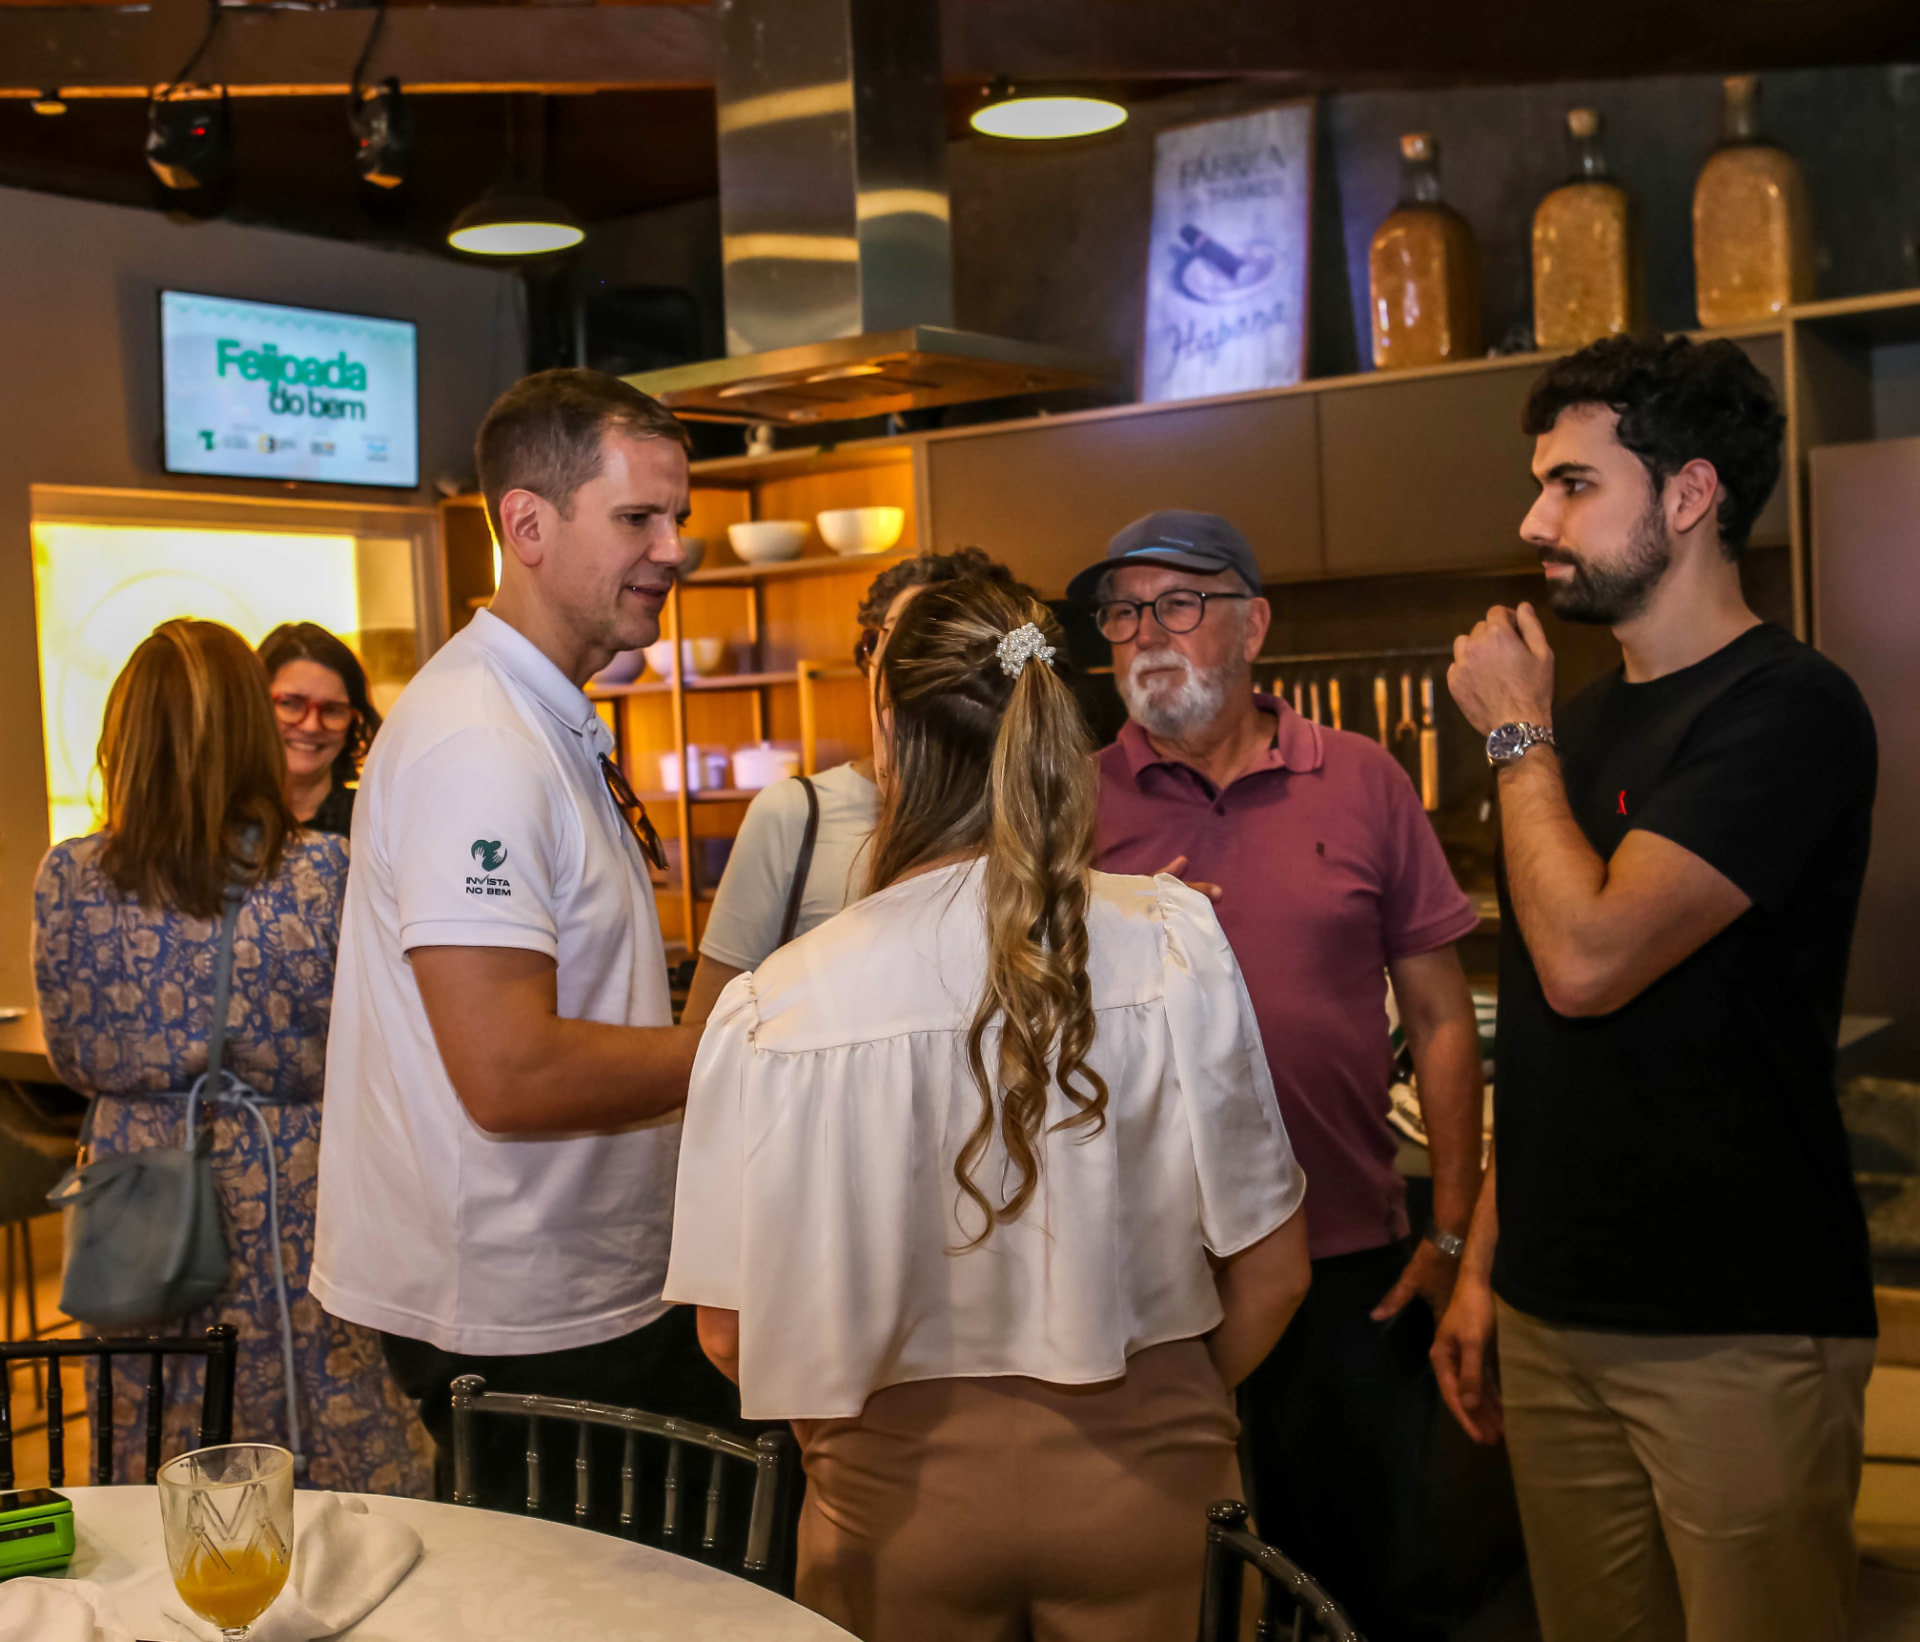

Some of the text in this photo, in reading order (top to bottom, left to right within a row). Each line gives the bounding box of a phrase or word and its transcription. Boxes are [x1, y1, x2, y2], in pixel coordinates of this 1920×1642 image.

[216, 338, 367, 393] Feijoada
[269, 387, 366, 421] do bem
[466, 874, 510, 887] INVISTA
[466, 886, 511, 896] NO BEM
